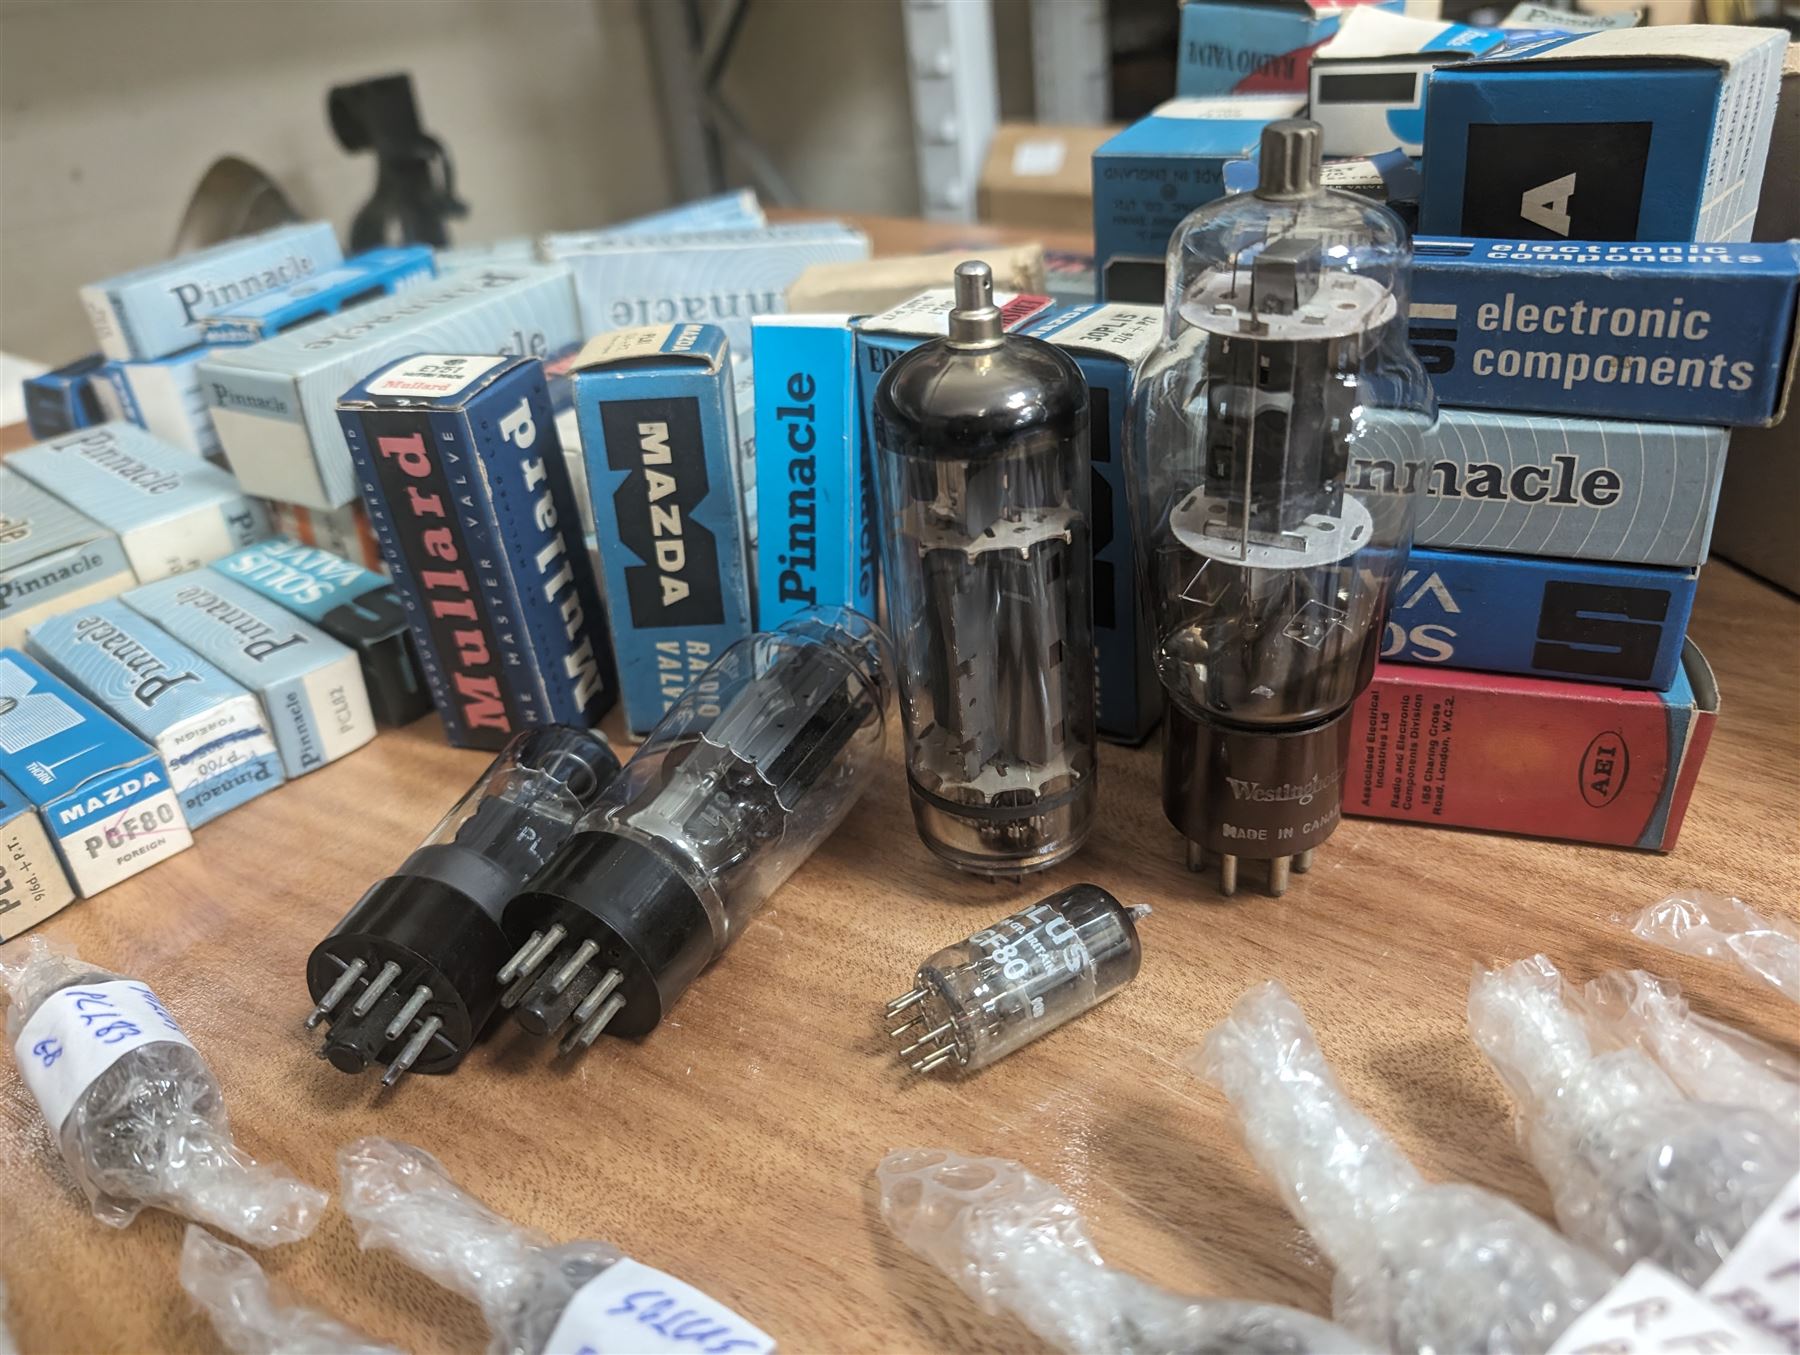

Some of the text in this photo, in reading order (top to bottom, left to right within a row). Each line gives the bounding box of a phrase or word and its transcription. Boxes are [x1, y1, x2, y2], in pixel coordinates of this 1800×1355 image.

[1486, 251, 1763, 265] components
[1491, 242, 1729, 256] electronic
[171, 252, 315, 326] Pinnacle
[1475, 292, 1711, 339] electronic
[1078, 311, 1139, 344] 30PL15
[381, 380, 451, 392] Mullard
[1471, 347, 1755, 391] components
[212, 382, 290, 415] Pinnacle
[48, 430, 184, 496] Pinnacle
[348, 428, 365, 466] LTD
[442, 431, 480, 529] VALVE
[777, 371, 818, 606] Pinnacle
[1345, 453, 1622, 507] nnacle
[365, 483, 404, 575] MULLARD
[638, 421, 691, 608] MAZDA
[0, 551, 105, 610] Pinnacle
[228, 551, 335, 605] SOLUS
[499, 396, 605, 715] Mullard
[376, 431, 511, 735] Mullard
[178, 586, 309, 663] Pinnacle
[479, 558, 522, 666] MASTER
[73, 613, 205, 708] Pinnacle
[173, 714, 237, 746] FOREIGN
[285, 690, 322, 771] Pinnacle
[1428, 703, 1441, 737] Cross
[25, 761, 55, 786] THORN
[1361, 690, 1380, 808] Associated Electrical
[1375, 711, 1390, 789] Industries Ltd
[1391, 694, 1411, 809] Radio and Electronic
[1402, 693, 1424, 811] Components Division
[1424, 739, 1440, 782] Charing
[1590, 745, 1617, 797] AEI
[59, 770, 162, 826] MAZDA
[185, 760, 273, 810] Pinnacle
[83, 802, 175, 860] PCF80
[116, 837, 167, 866] FOREIGN
[1222, 822, 1268, 842] MADE
[1278, 827, 1294, 840] IN
[1024, 933, 1058, 975] BRITAIN
[65, 990, 142, 1044] PCL83
